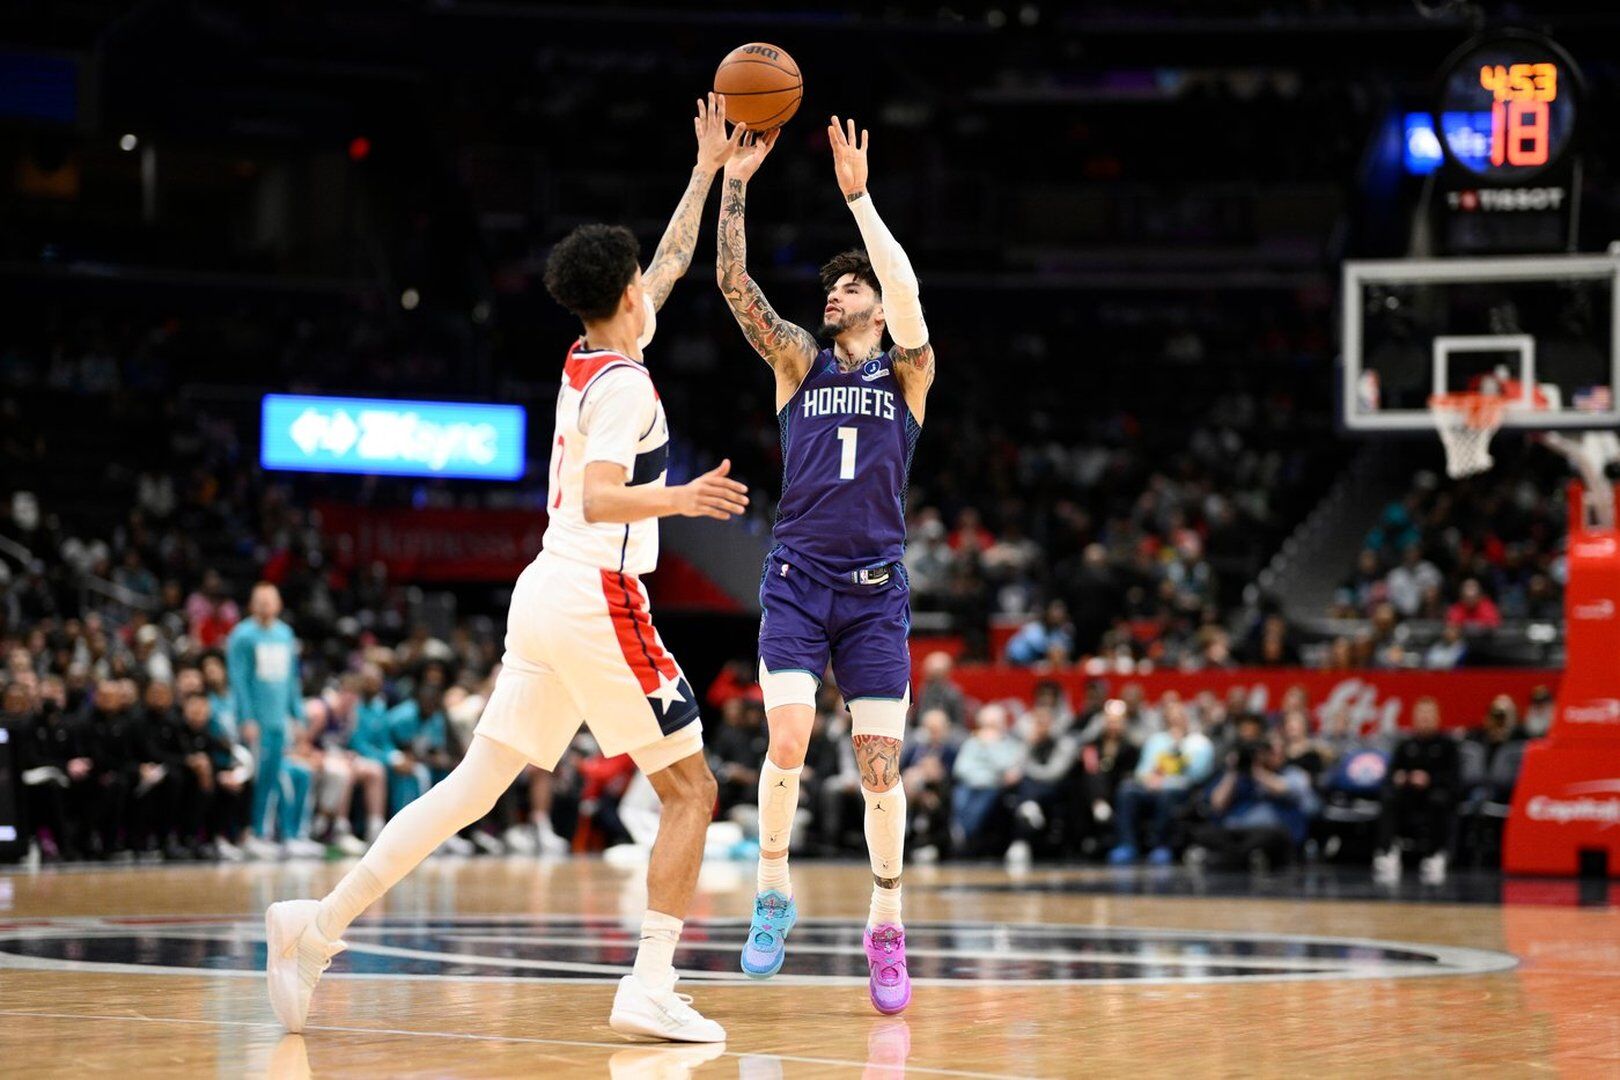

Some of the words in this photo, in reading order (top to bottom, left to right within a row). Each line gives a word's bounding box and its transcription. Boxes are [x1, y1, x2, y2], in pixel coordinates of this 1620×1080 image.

[1491, 99, 1550, 168] 18
[802, 386, 896, 420] HORNETS
[837, 426, 858, 480] 1
